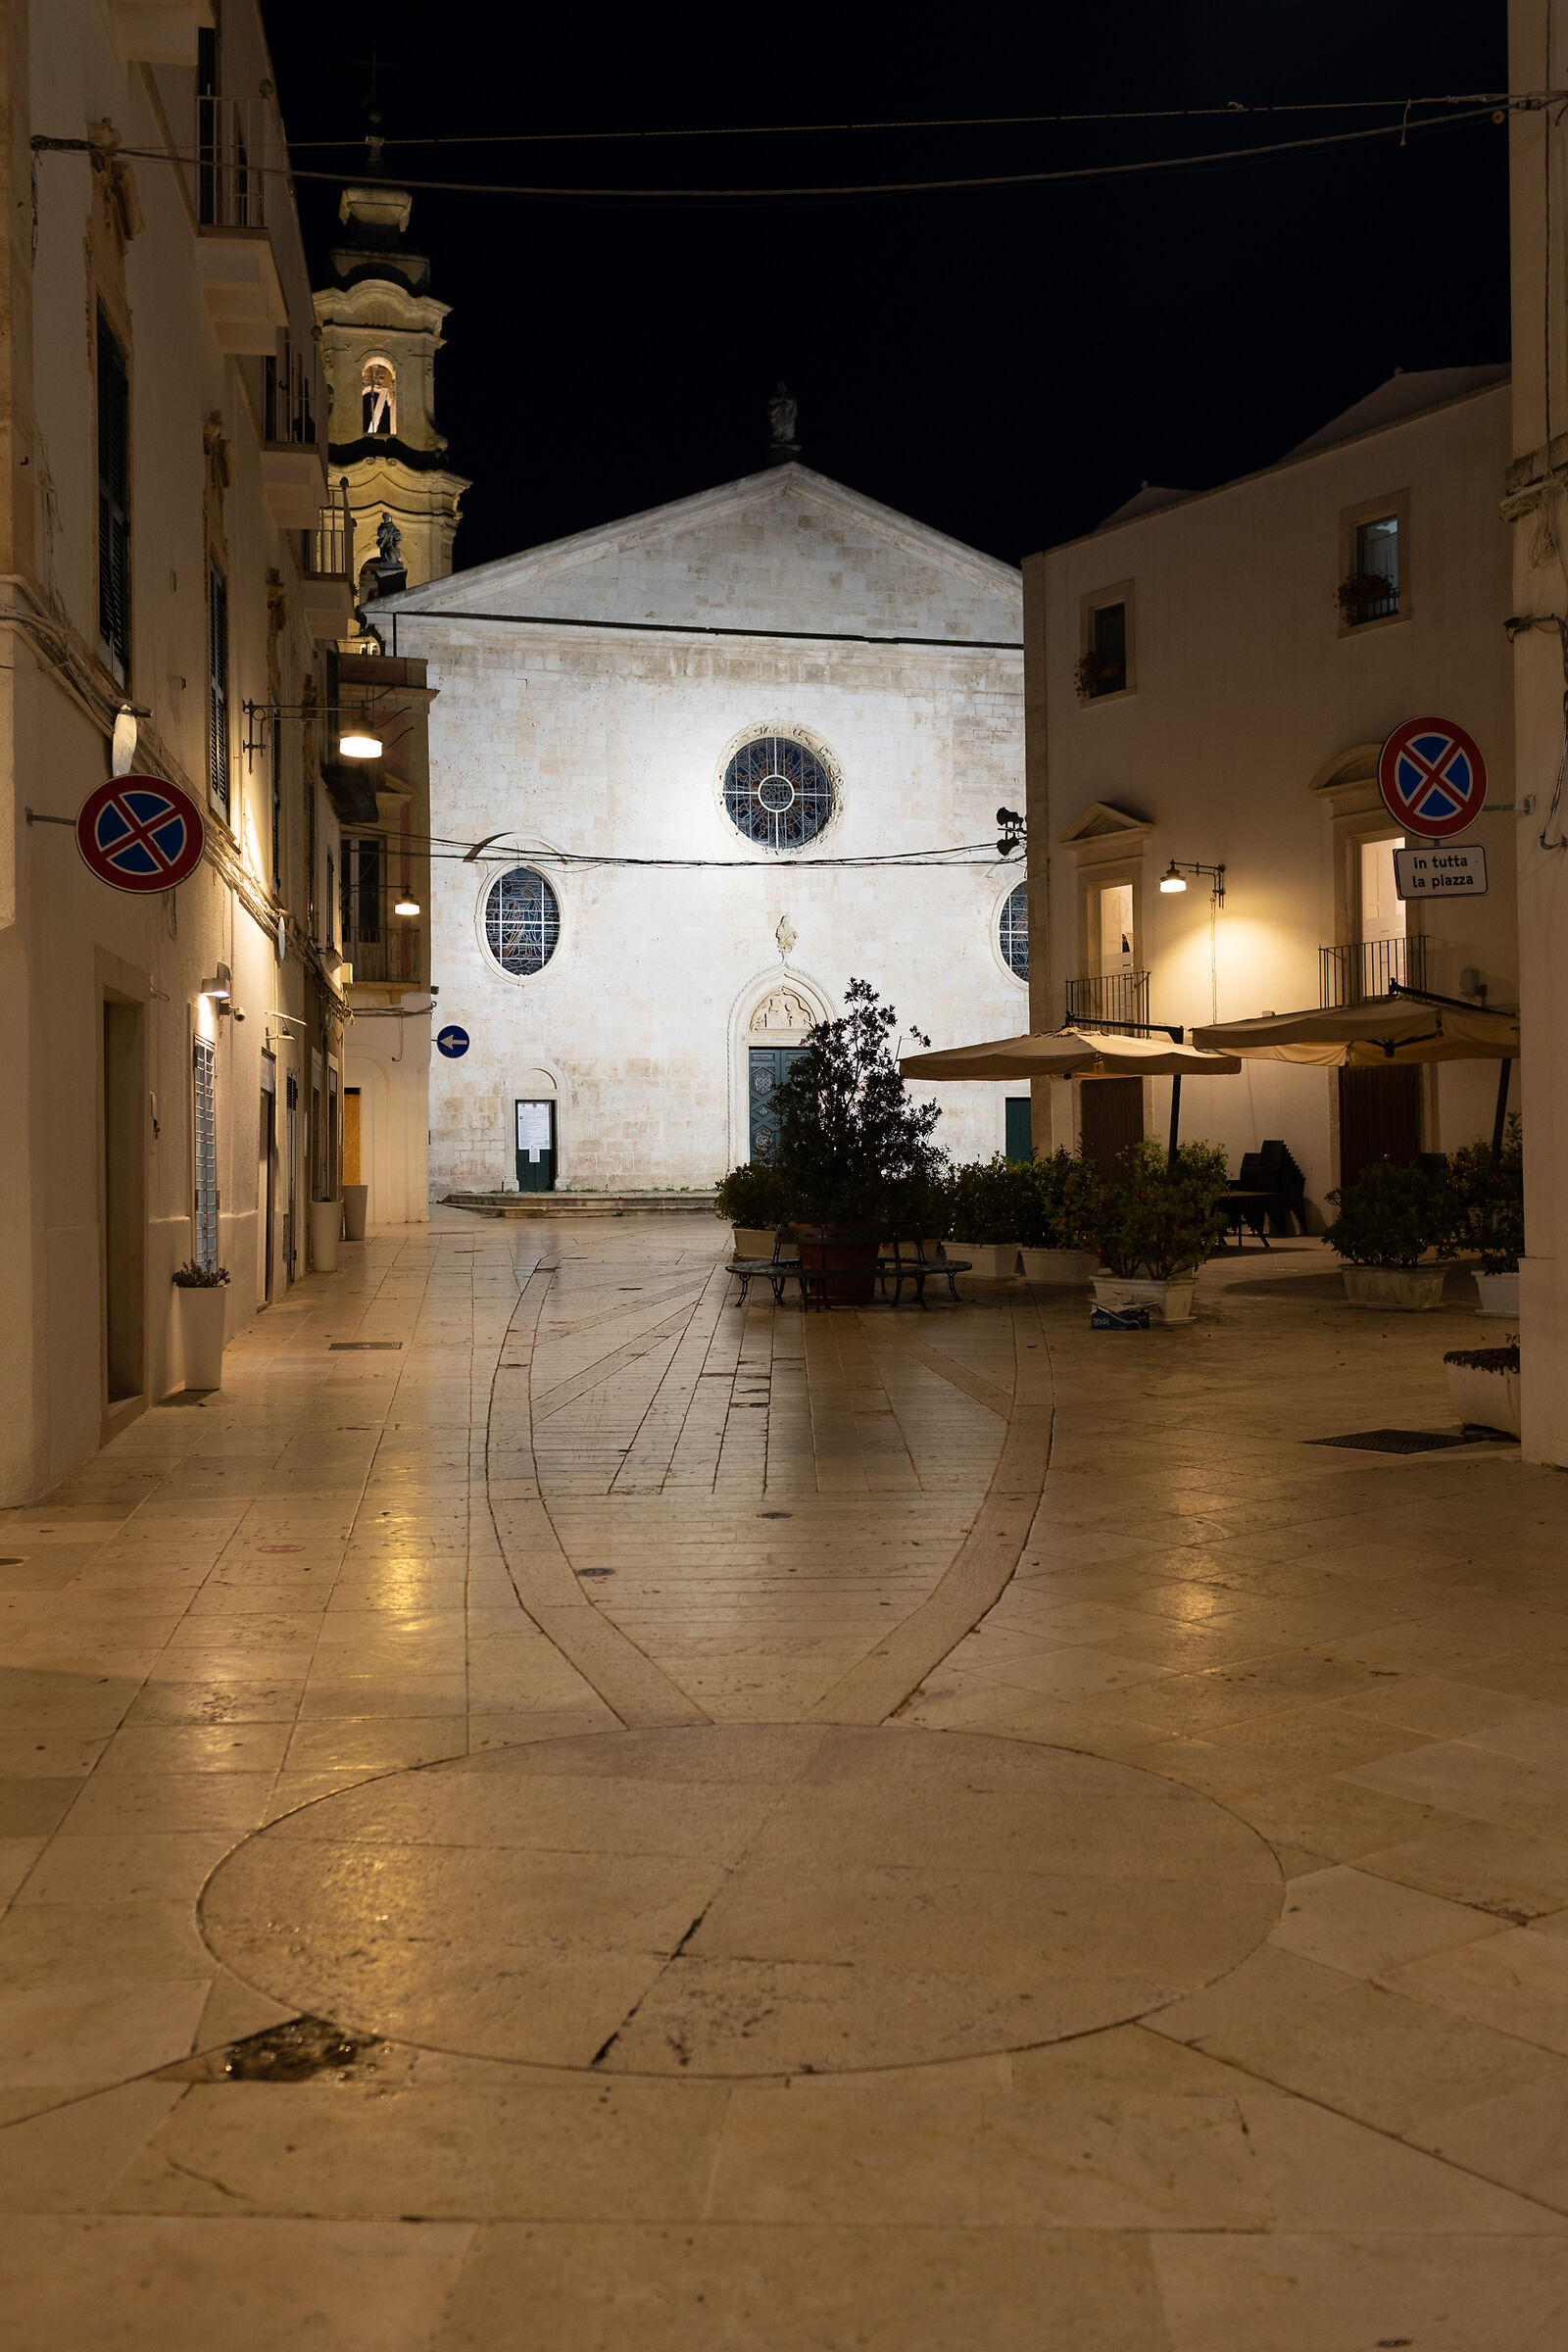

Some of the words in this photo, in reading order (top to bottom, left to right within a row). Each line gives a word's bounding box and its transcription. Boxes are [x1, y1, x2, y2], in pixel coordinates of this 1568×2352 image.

[1413, 857, 1427, 869] in
[1432, 855, 1468, 868] tutta
[1412, 875, 1426, 888] la
[1432, 874, 1474, 889] piazza
